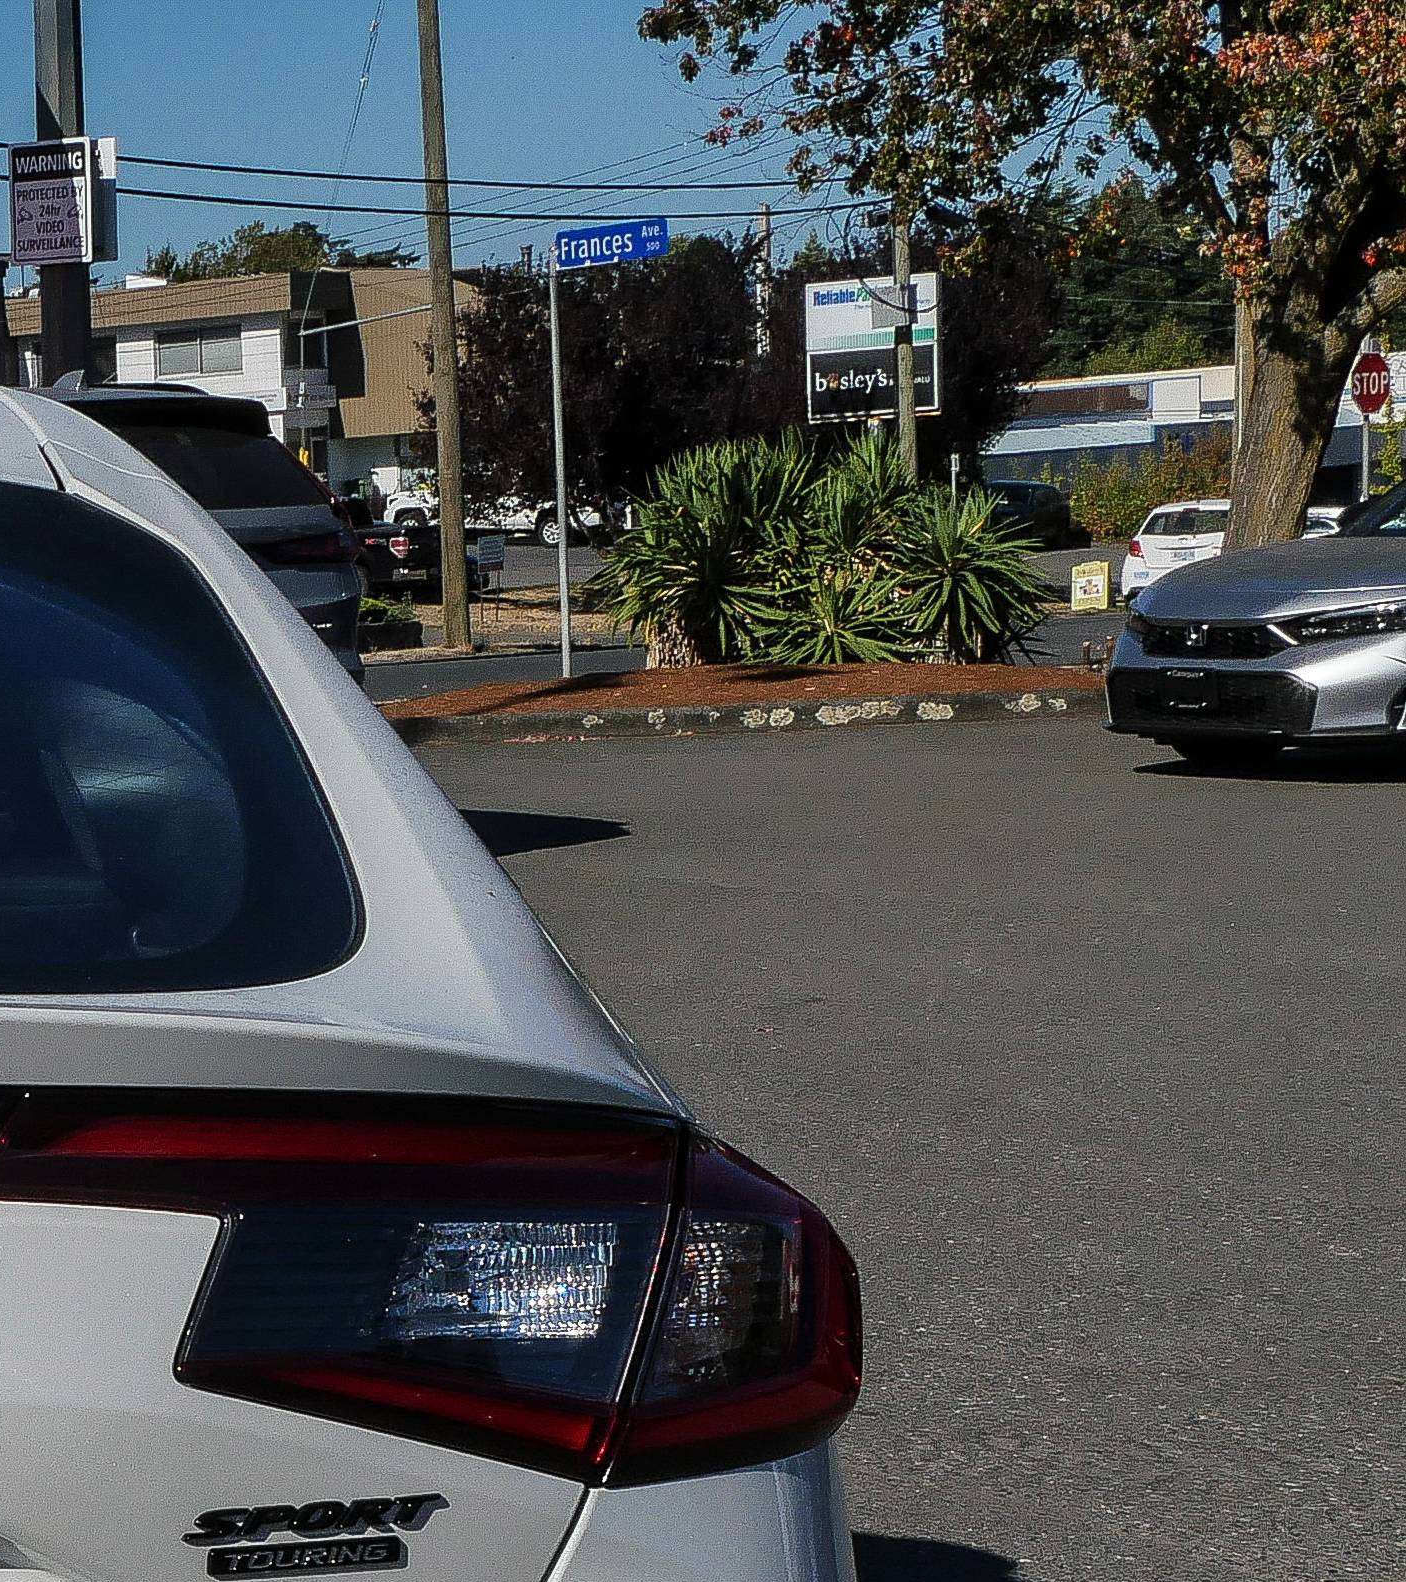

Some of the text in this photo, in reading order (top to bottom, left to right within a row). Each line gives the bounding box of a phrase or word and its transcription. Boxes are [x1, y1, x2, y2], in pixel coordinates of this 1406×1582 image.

[15, 151, 83, 174] WARNING
[16, 186, 69, 202] PROTECTED
[39, 203, 62, 218] 24hr
[35, 221, 65, 235] VIDEO
[17, 236, 84, 252] SURVEILLANCE
[560, 225, 664, 261] Frances Ave.
[813, 286, 870, 307] ReliablePa
[1353, 371, 1389, 396] STOP
[179, 1491, 452, 1548] SPORT
[223, 1543, 391, 1571] TOURING
